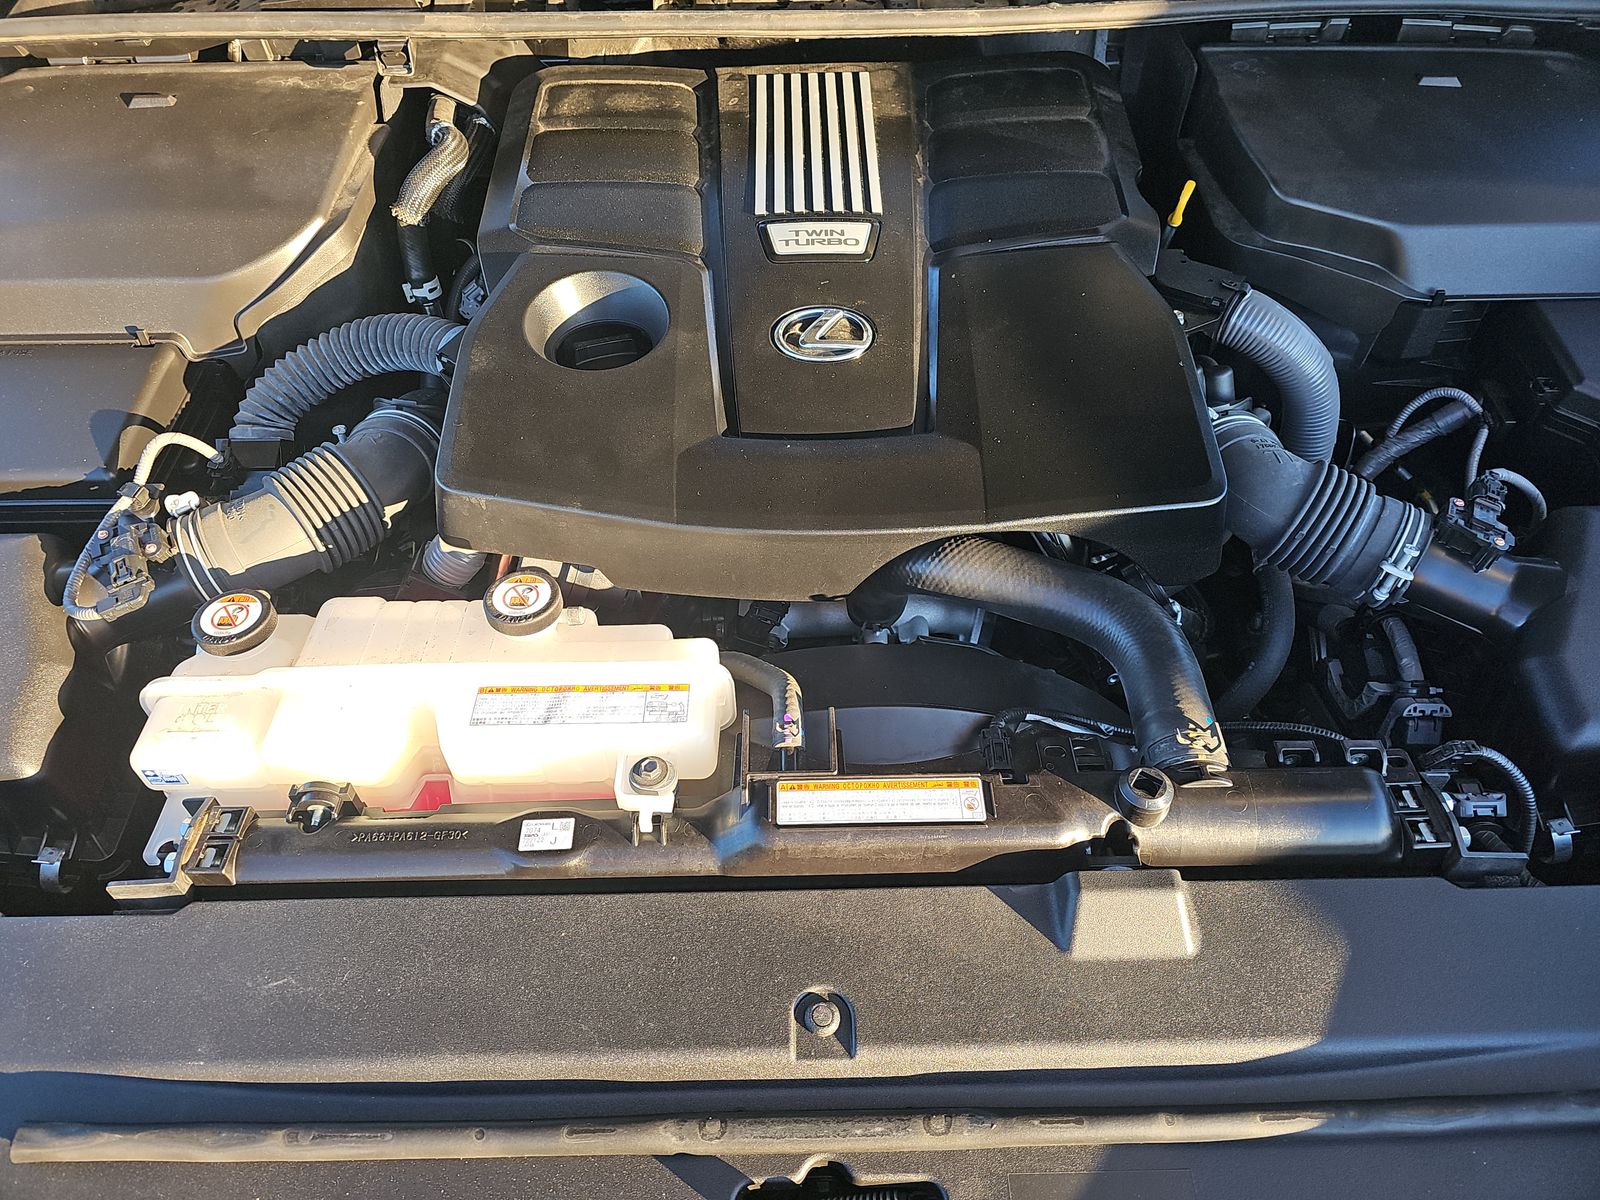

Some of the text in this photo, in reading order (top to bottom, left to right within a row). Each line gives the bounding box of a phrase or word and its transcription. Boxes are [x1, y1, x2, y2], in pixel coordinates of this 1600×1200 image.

[788, 229, 845, 237] TWIN
[778, 238, 860, 247] TURBO
[882, 781, 928, 789] AVERTISSEMENT
